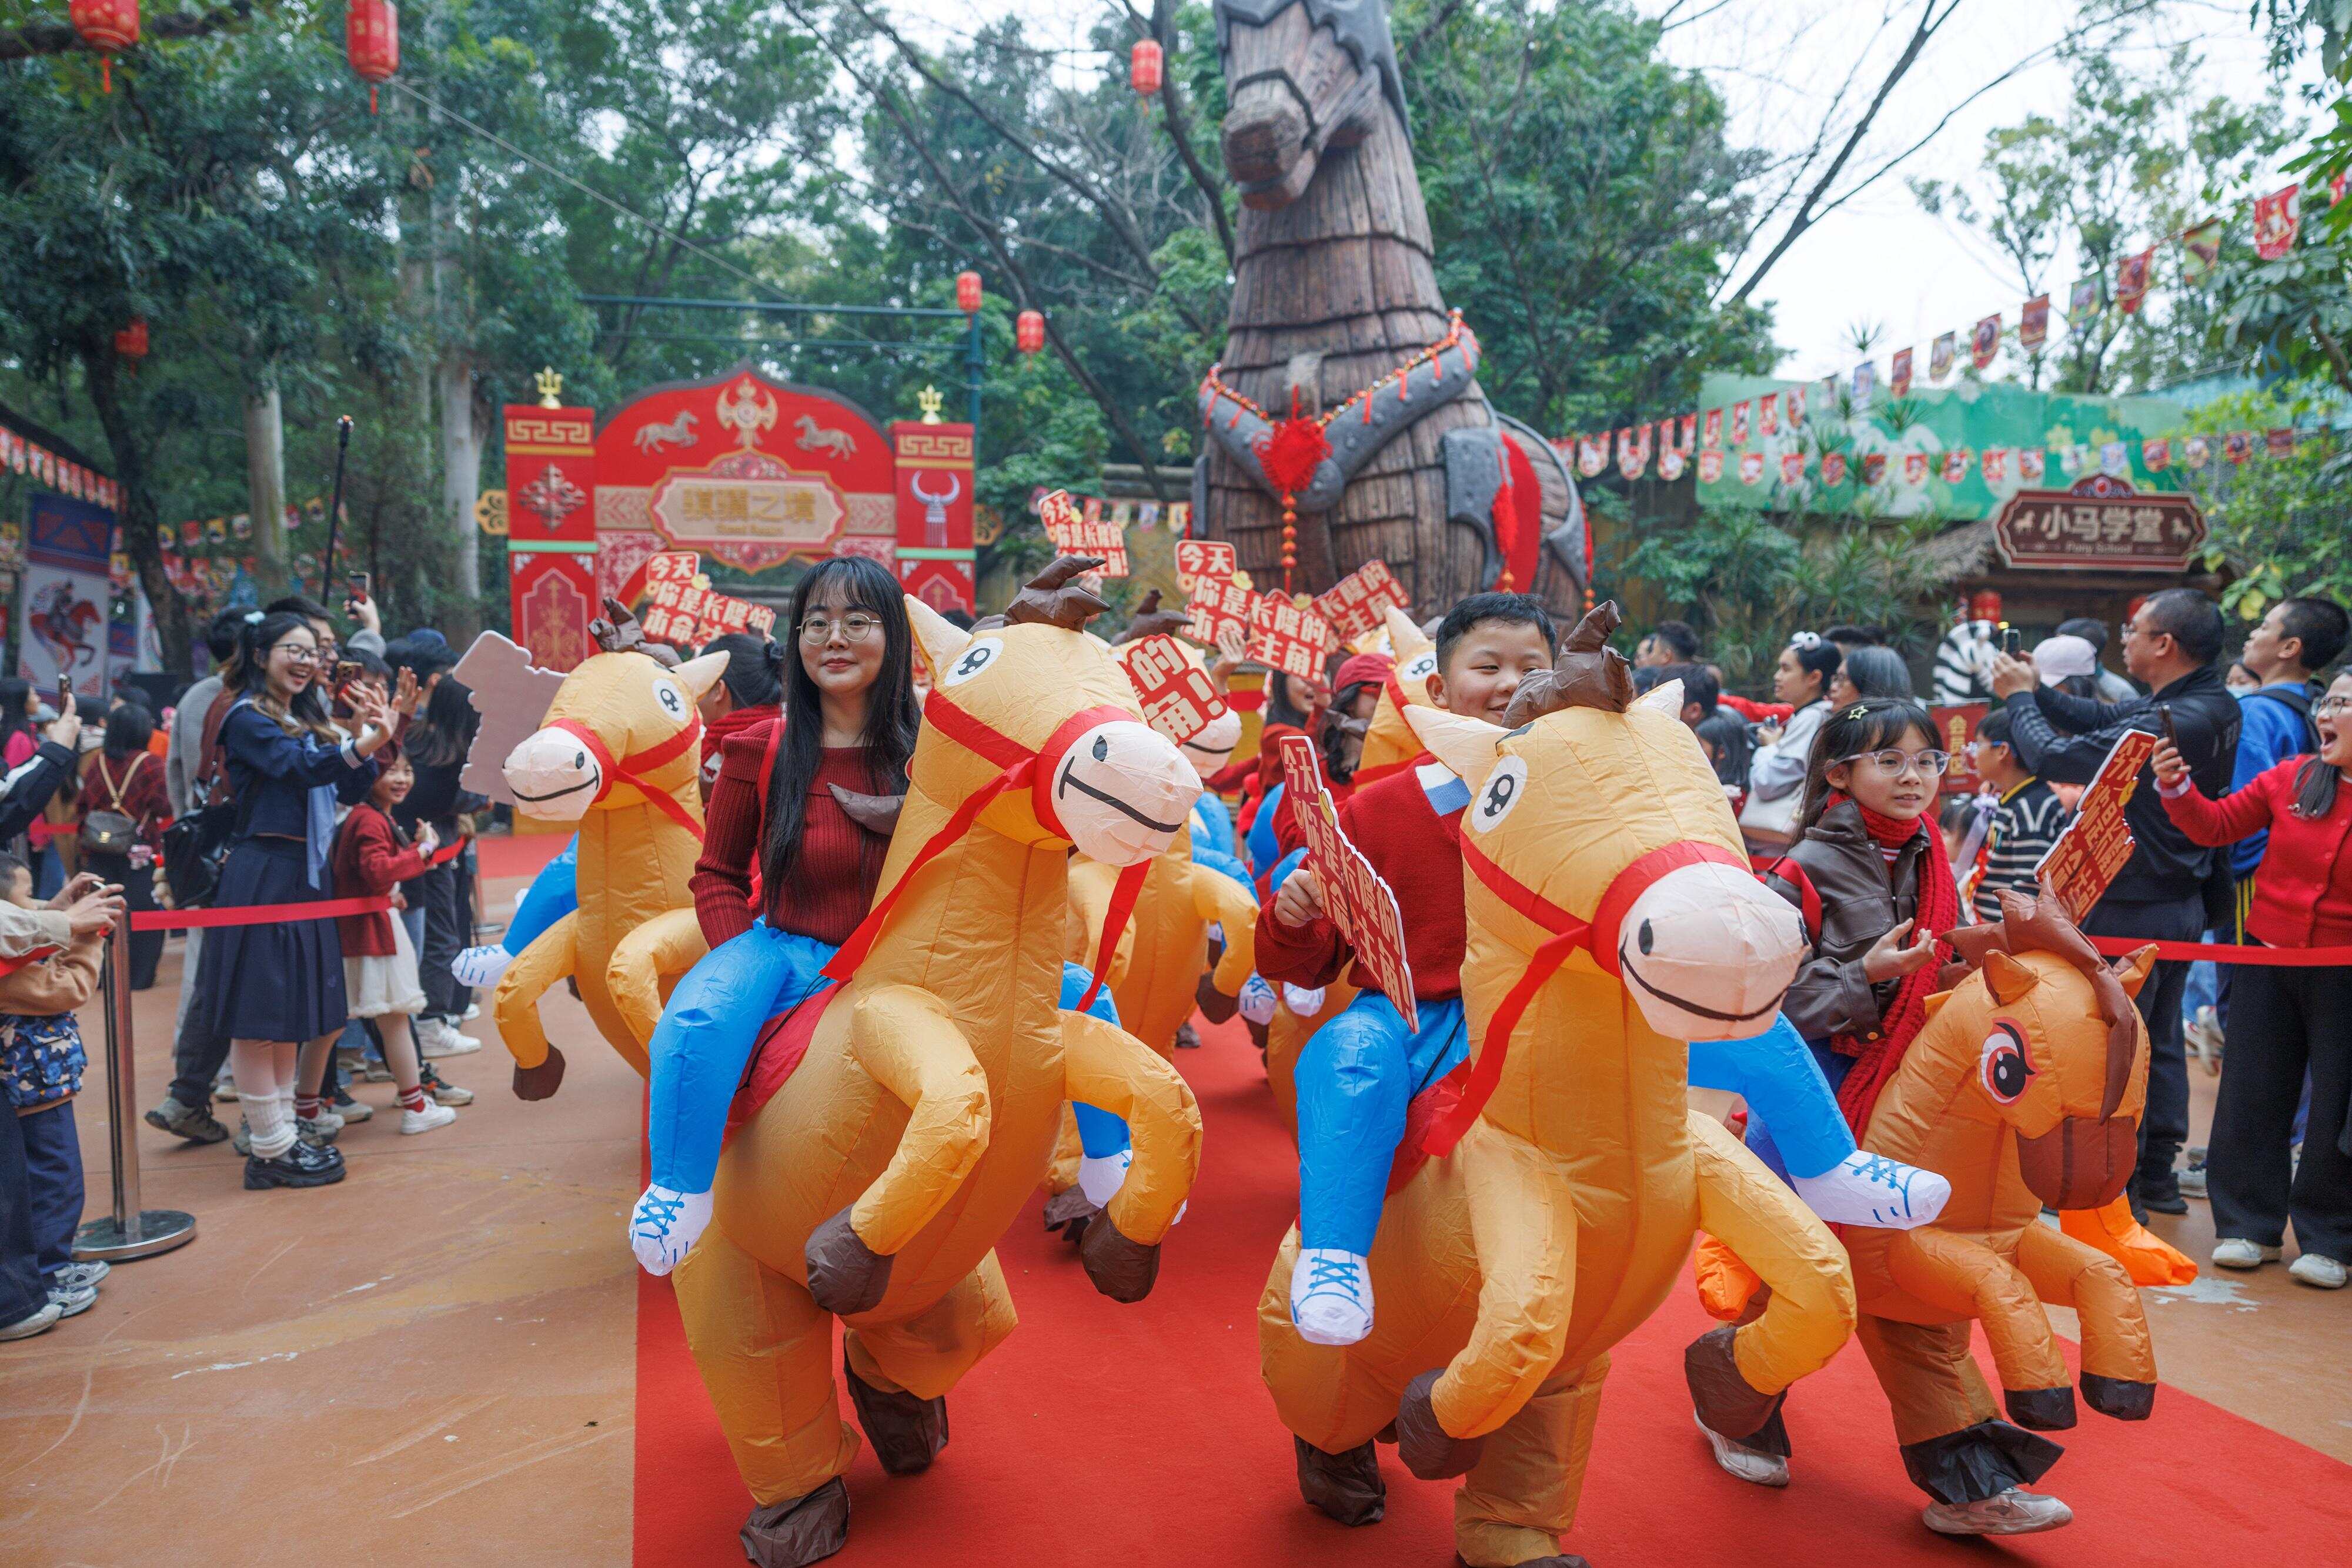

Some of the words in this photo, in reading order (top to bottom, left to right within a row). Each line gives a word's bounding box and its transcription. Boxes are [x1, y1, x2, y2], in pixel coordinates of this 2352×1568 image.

[1043, 493, 1070, 524] 今天
[2040, 504, 2164, 543] 小马学堂
[1056, 523, 1124, 549] 你是长隆的
[1180, 544, 1231, 574] 今天
[651, 556, 693, 579] 今天
[1319, 560, 1390, 618] 长隆的
[655, 580, 773, 634] 你是长隆的
[1194, 574, 1326, 647] 你是长隆的
[1284, 744, 1317, 794] 今天
[2106, 737, 2152, 781] 今天
[1302, 798, 1400, 955] 你是长隆的
[1307, 858, 1415, 1033] 本命主角!
